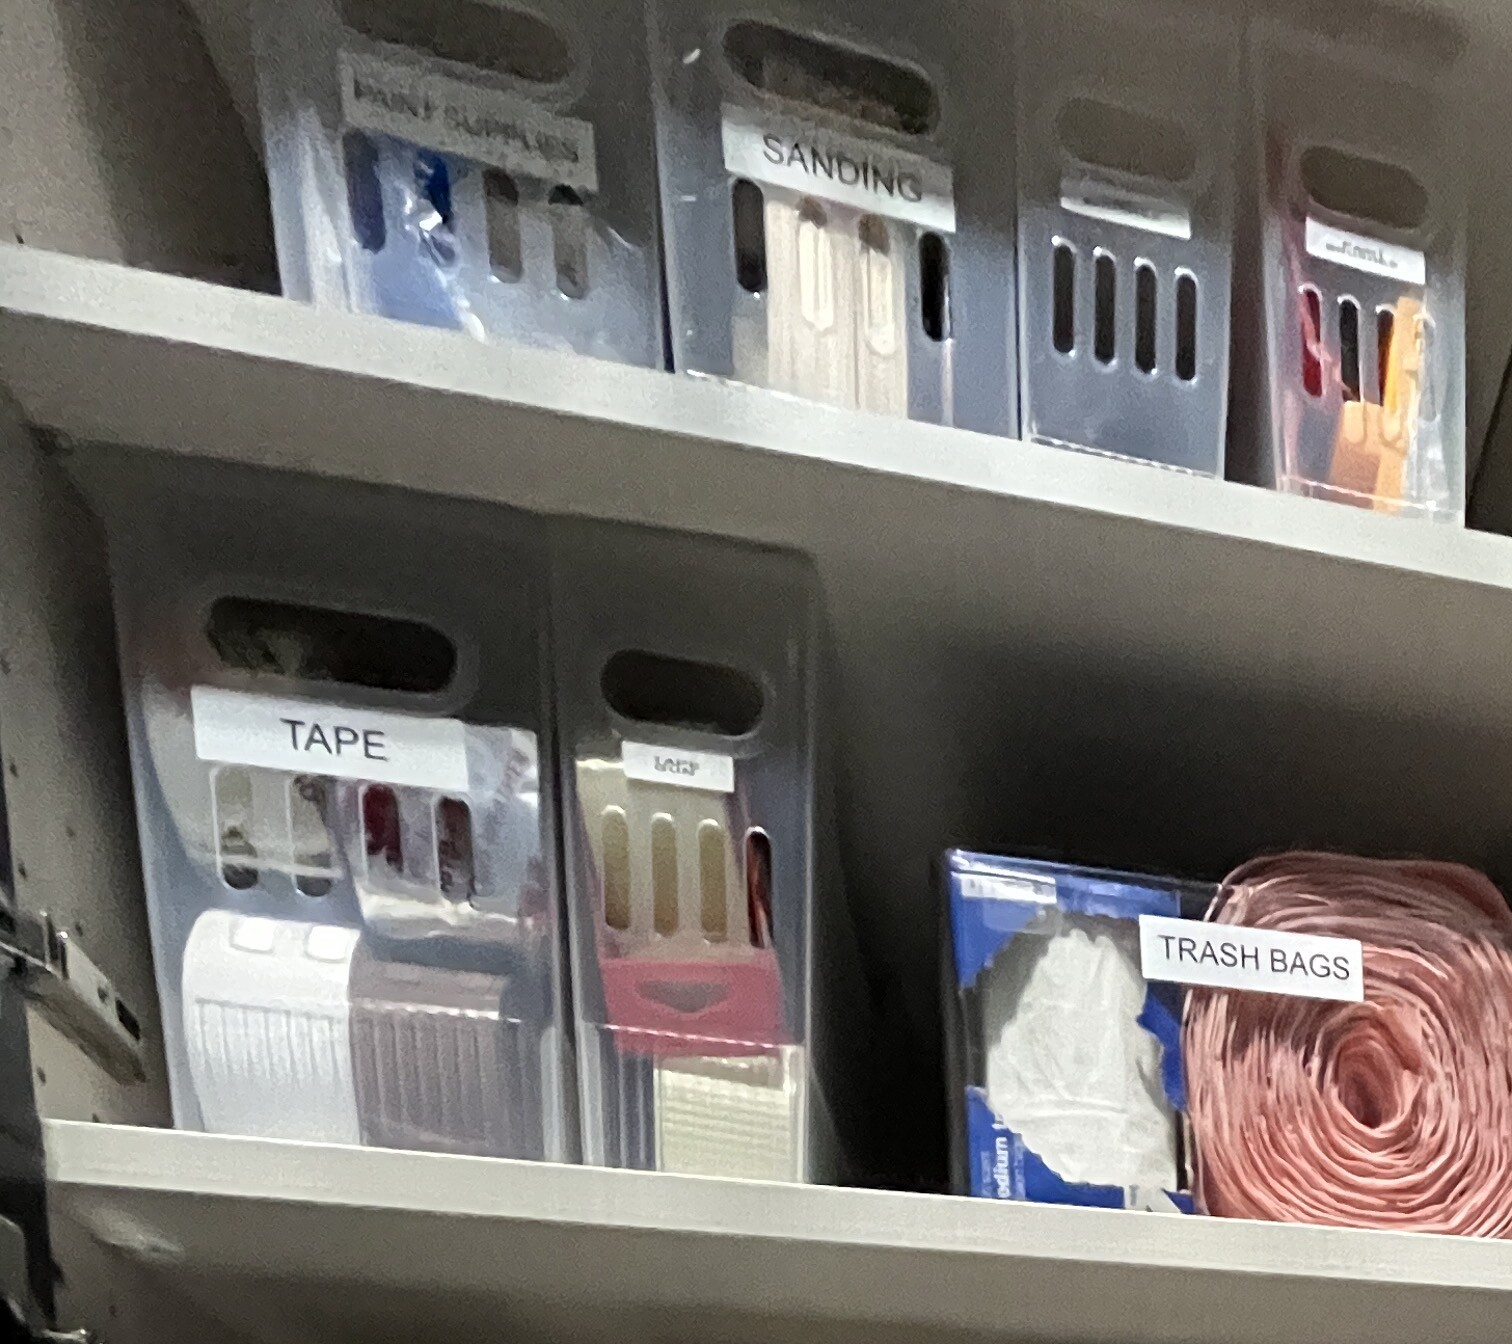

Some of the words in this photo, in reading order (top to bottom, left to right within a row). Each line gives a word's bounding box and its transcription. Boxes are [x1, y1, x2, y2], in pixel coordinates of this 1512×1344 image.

[762, 133, 922, 202] SANDING
[280, 718, 389, 762] TAPE
[1159, 933, 1261, 970] TRASH
[1270, 951, 1350, 981] BAGS
[991, 1136, 1013, 1199] edium
